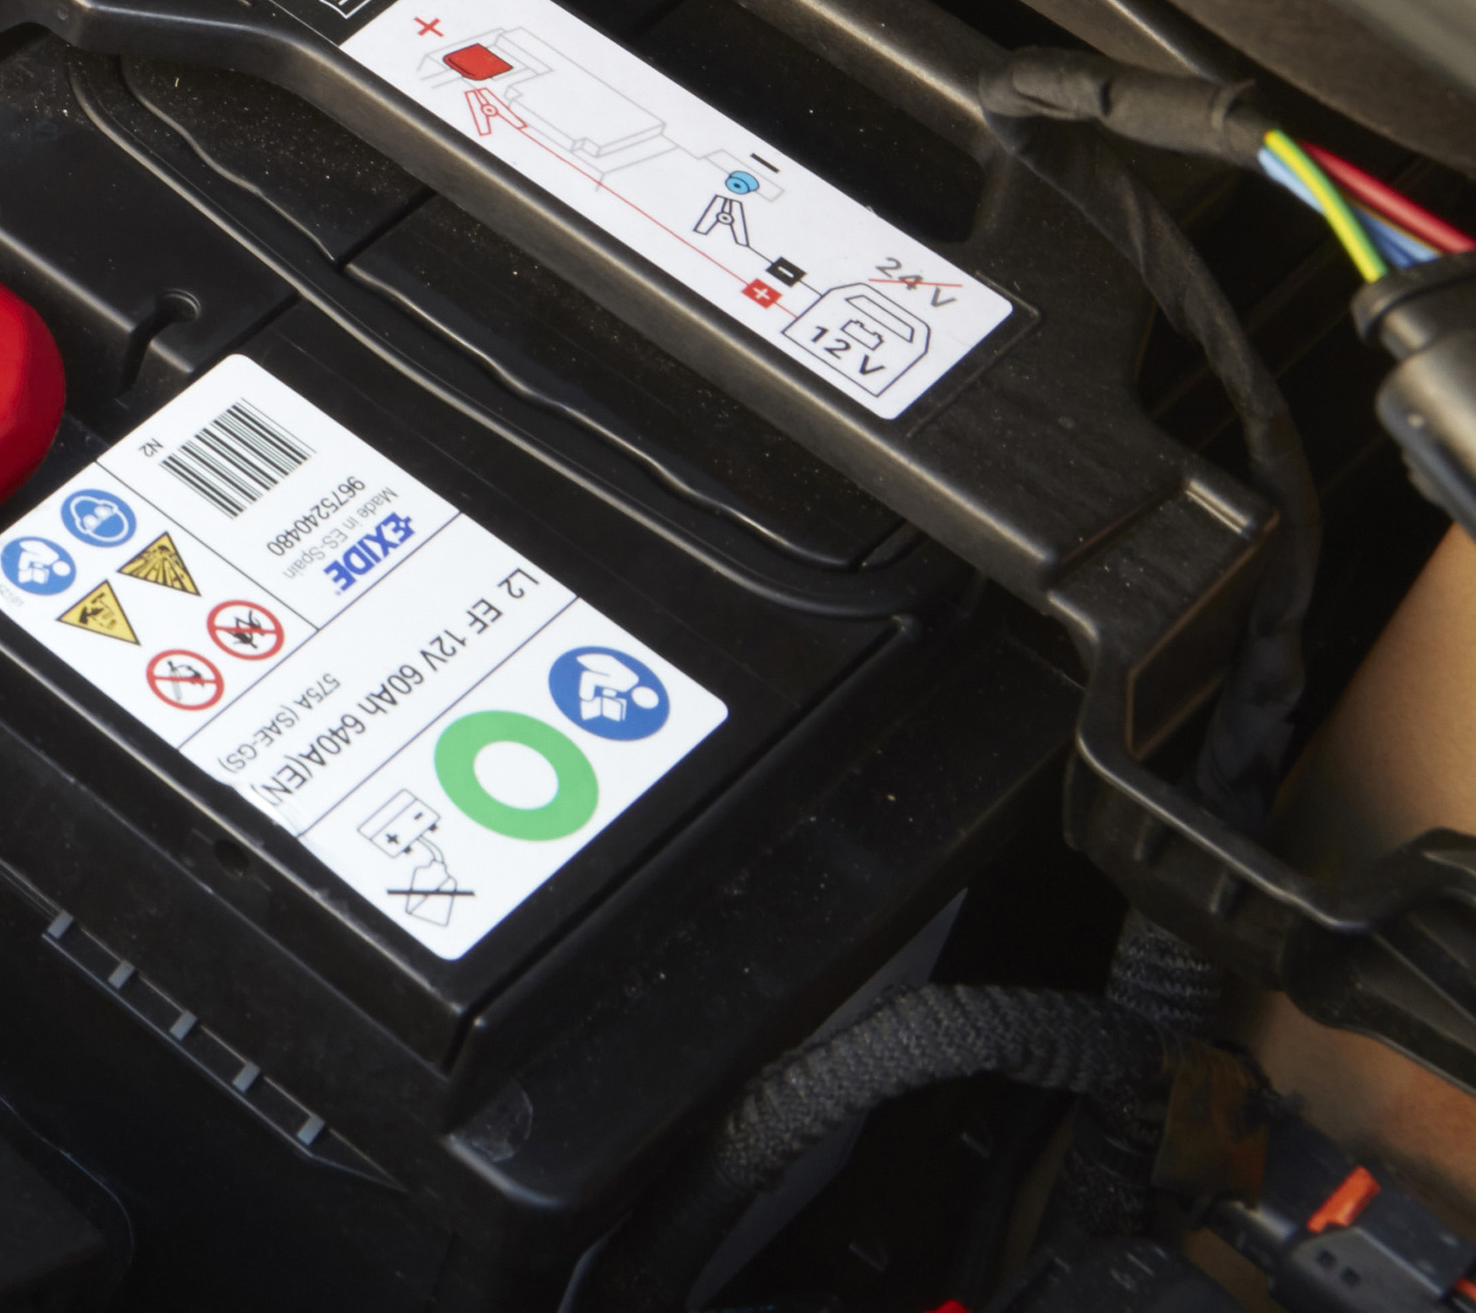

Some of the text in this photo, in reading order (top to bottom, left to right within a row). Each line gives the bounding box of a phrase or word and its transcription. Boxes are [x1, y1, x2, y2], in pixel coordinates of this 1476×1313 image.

[138, 437, 164, 457] N2
[266, 475, 366, 557] 9675240480
[282, 486, 399, 580] Made in ES-Spain
[323, 511, 416, 592] EXIDE
[497, 567, 540, 600] L2
[466, 598, 504, 635] EF
[419, 629, 468, 672] 12V
[358, 663, 425, 715] 60Ah
[216, 672, 341, 774] 575A (SAE-GS)
